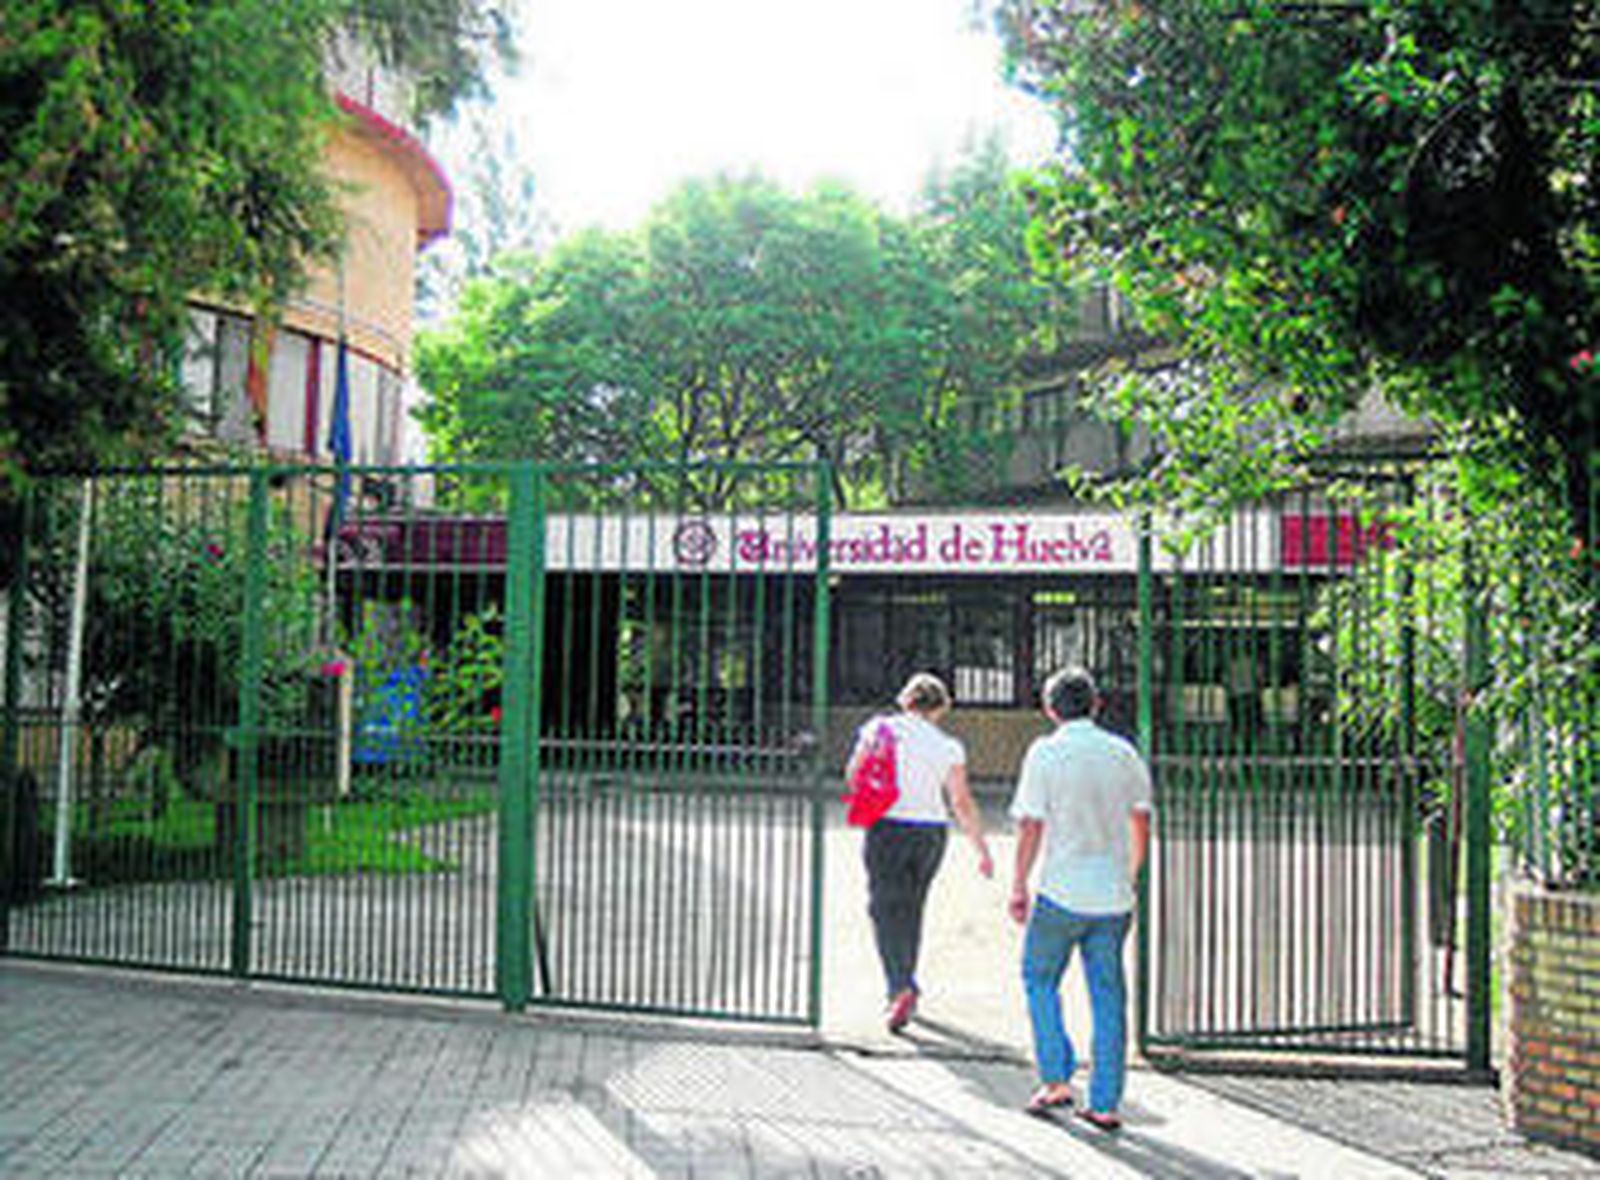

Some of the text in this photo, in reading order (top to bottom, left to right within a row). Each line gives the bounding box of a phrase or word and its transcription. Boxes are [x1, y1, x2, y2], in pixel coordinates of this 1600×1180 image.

[739, 523, 1112, 563] Univrsidad de Huelva
